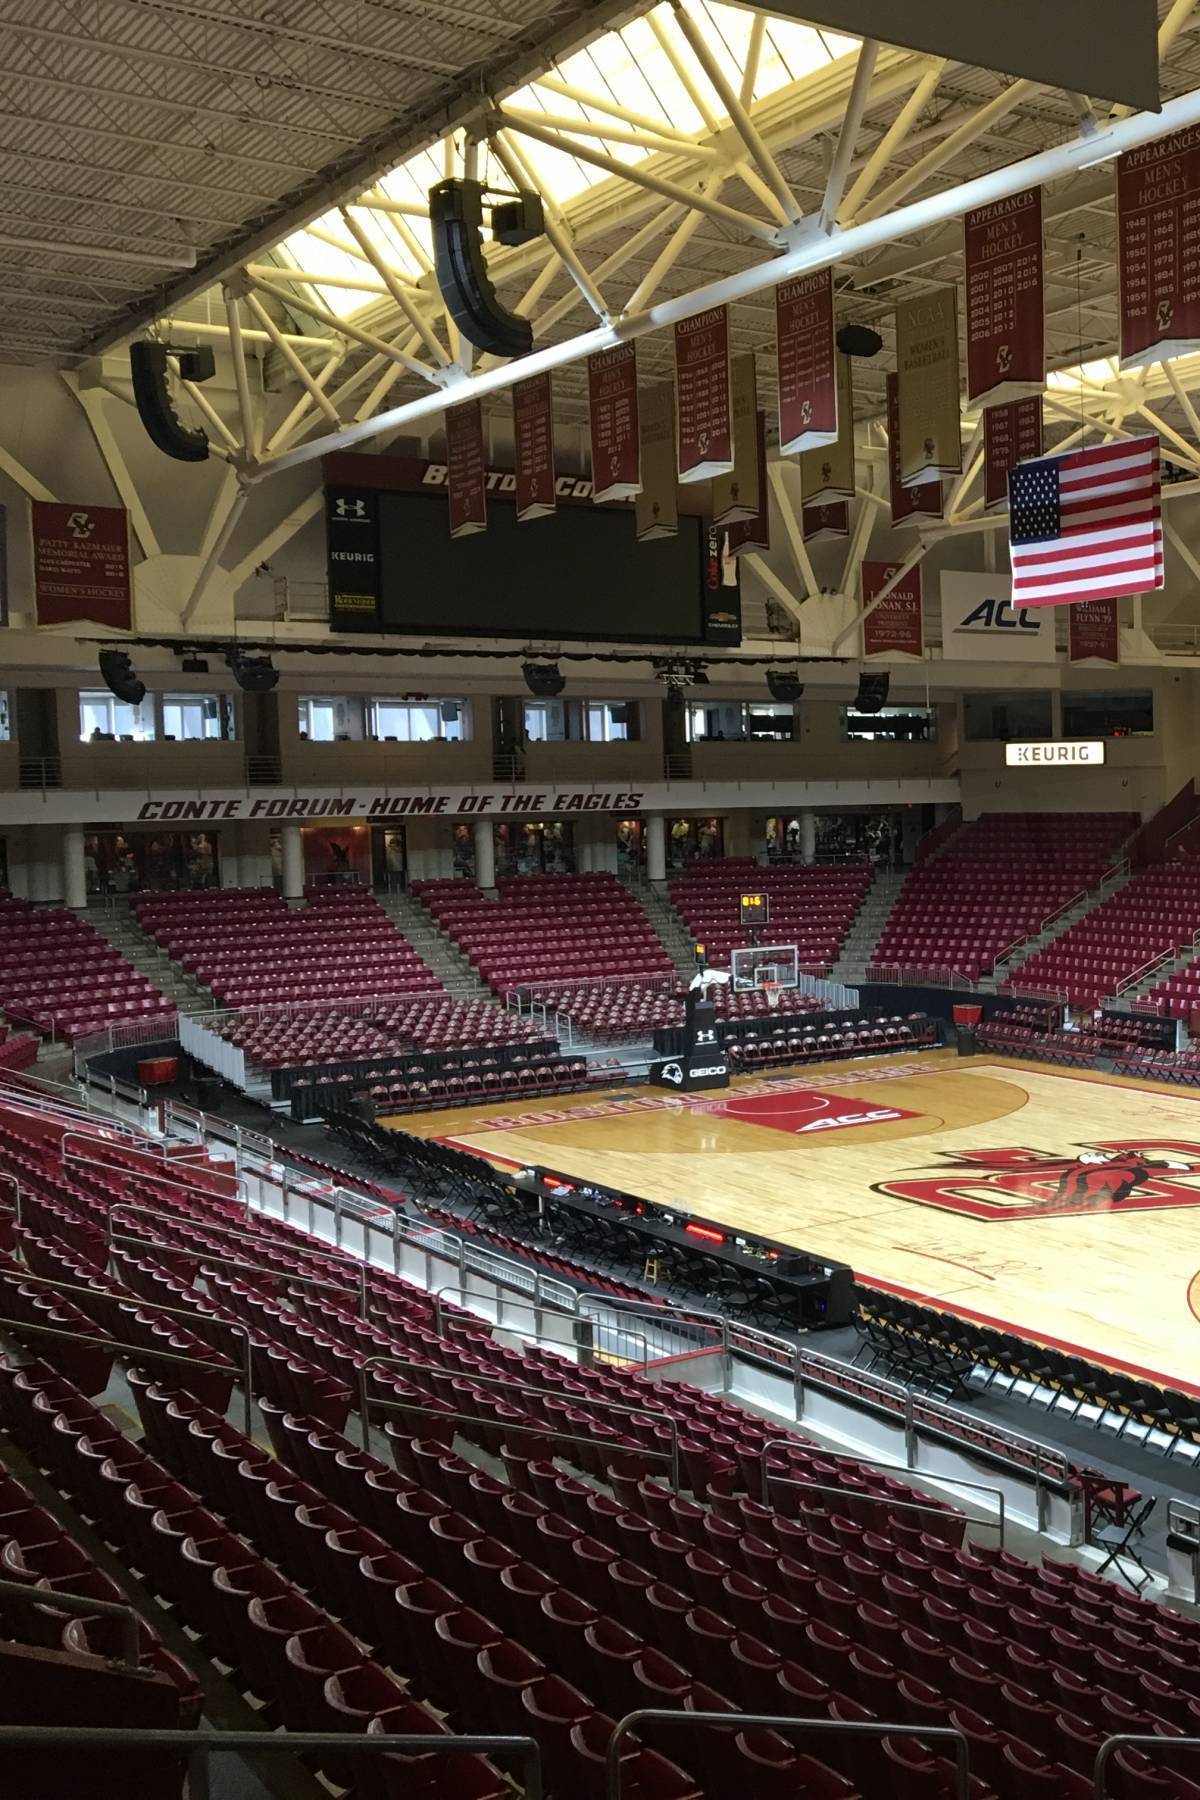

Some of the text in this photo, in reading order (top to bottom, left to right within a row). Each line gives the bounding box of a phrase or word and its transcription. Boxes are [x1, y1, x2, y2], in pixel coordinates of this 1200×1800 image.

[1126, 128, 1200, 168] APPEARANCES
[1145, 159, 1181, 185] MEN'S
[1138, 176, 1189, 205] HOCKEY
[969, 191, 1034, 226] APPEARANCES
[987, 218, 1017, 241] MEN'S
[981, 232, 1024, 259] HOCKEY
[1016, 254, 1038, 267] 2014
[1016, 266, 1038, 279] 2015
[778, 271, 829, 303] CHAMPIONS
[1016, 279, 1038, 291] 2016
[677, 308, 724, 334] CHAMPIONS
[789, 311, 819, 331] HOCKEY
[590, 347, 634, 371] CHAMPIONS
[708, 526, 718, 557] zero
[38, 547, 124, 562] MEMORIAL AWARD
[331, 551, 375, 562] KEURIG
[87, 588, 125, 598] HOCKEY
[960, 599, 1041, 629] ACC
[1018, 746, 1089, 761] KEURIG
[137, 800, 242, 820] CONTE
[457, 796, 494, 812] OF
[500, 794, 547, 811] THE
[553, 793, 643, 811] EAGLES
[690, 1066, 726, 1077] GEICO
[796, 1110, 902, 1133] ACC
